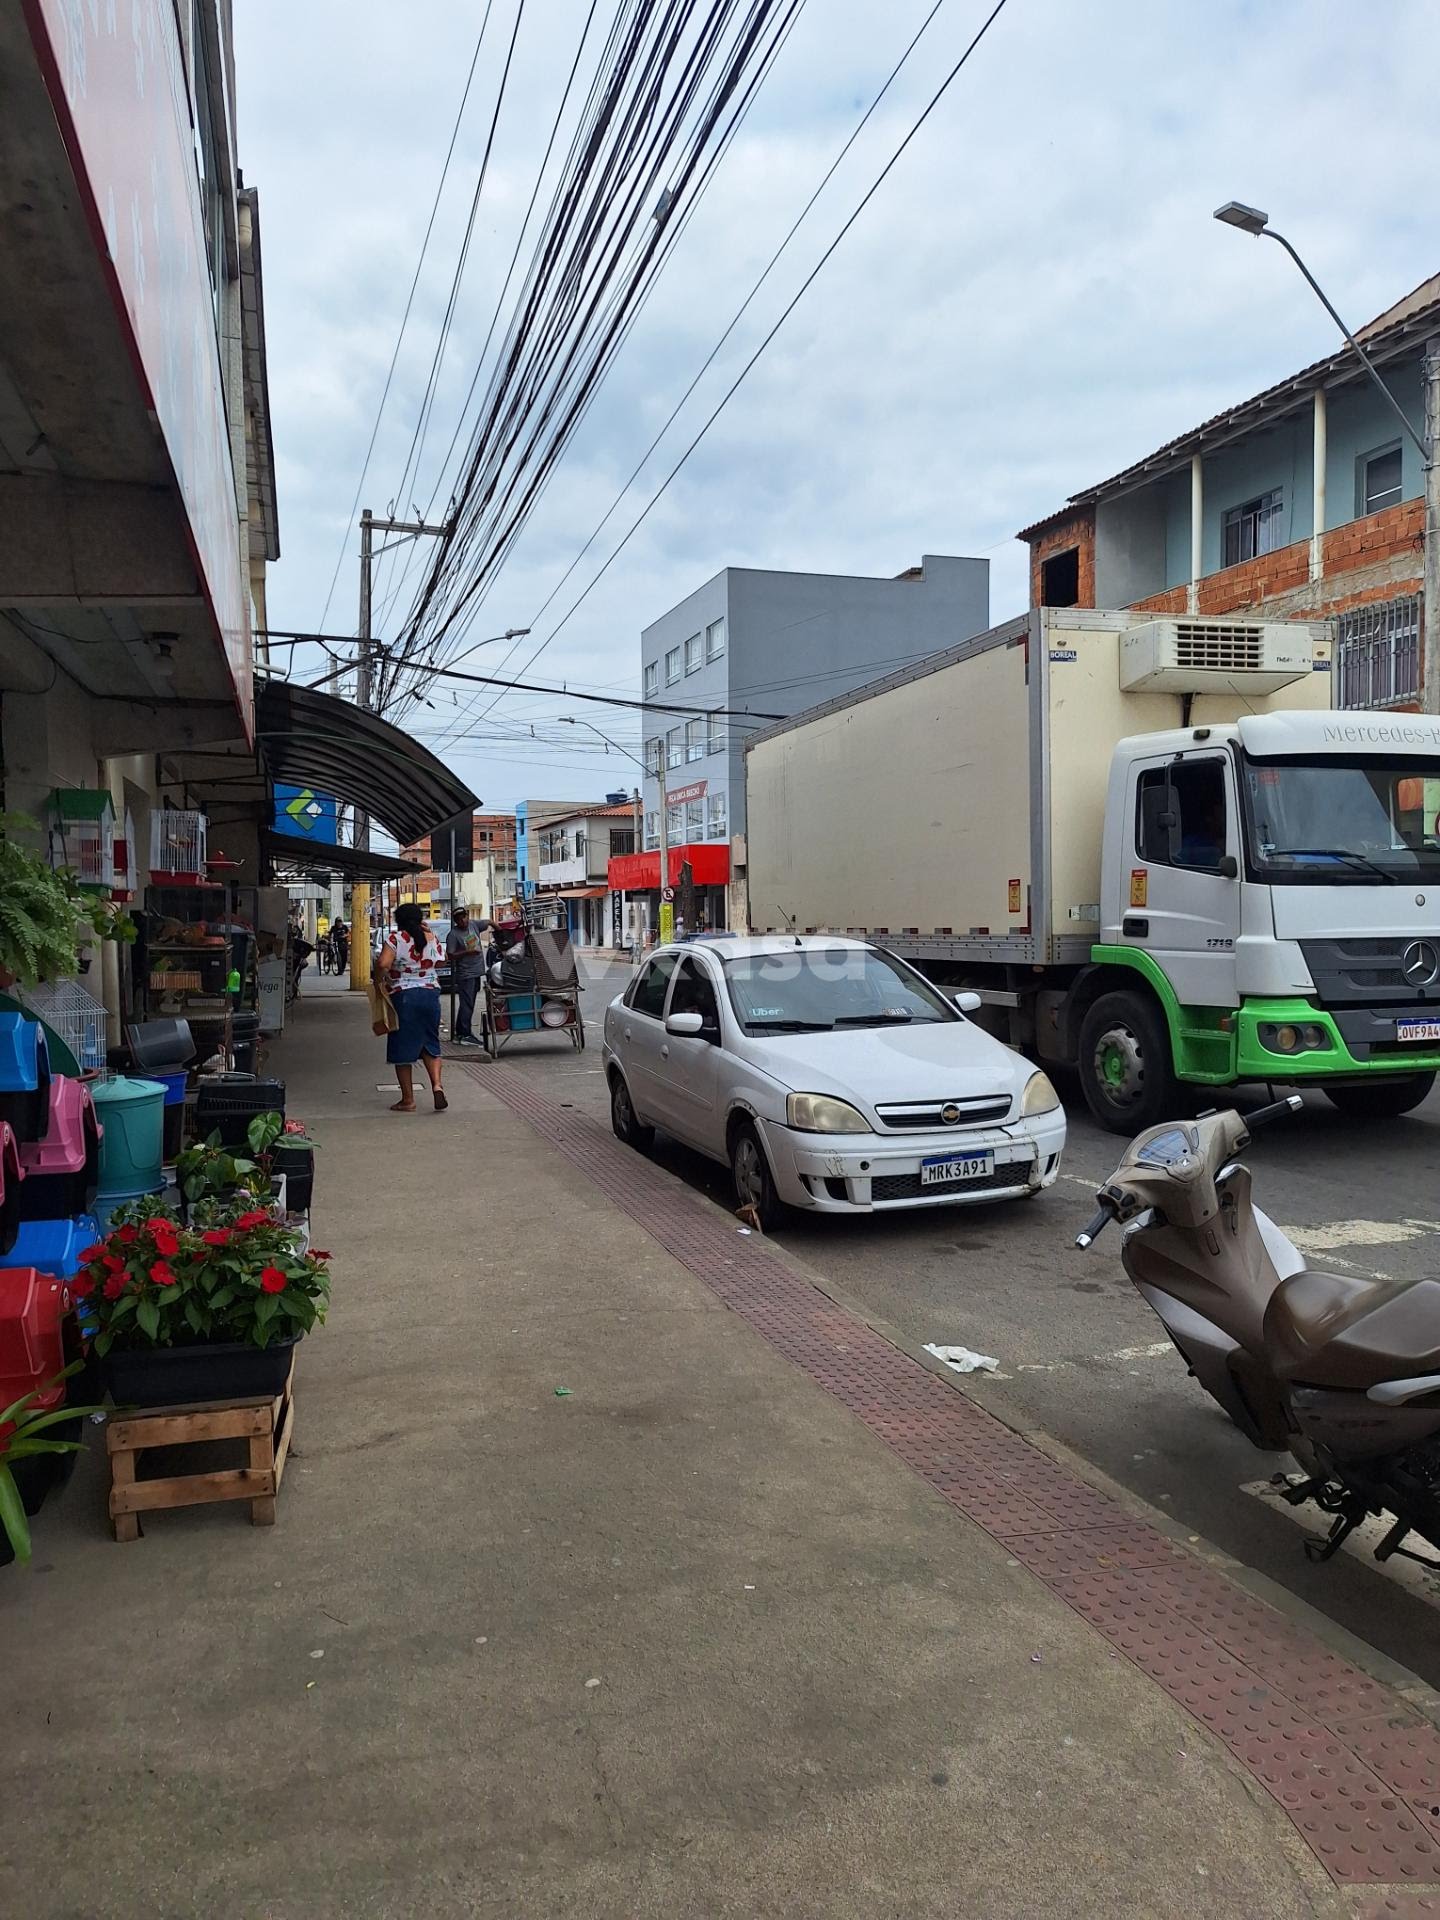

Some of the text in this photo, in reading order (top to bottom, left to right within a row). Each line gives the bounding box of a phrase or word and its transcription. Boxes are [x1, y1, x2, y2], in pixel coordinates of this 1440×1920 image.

[1050, 651, 1077, 659] BOREAL
[752, 1008, 781, 1016] Uber
[928, 1159, 987, 1181] MRK3A91
